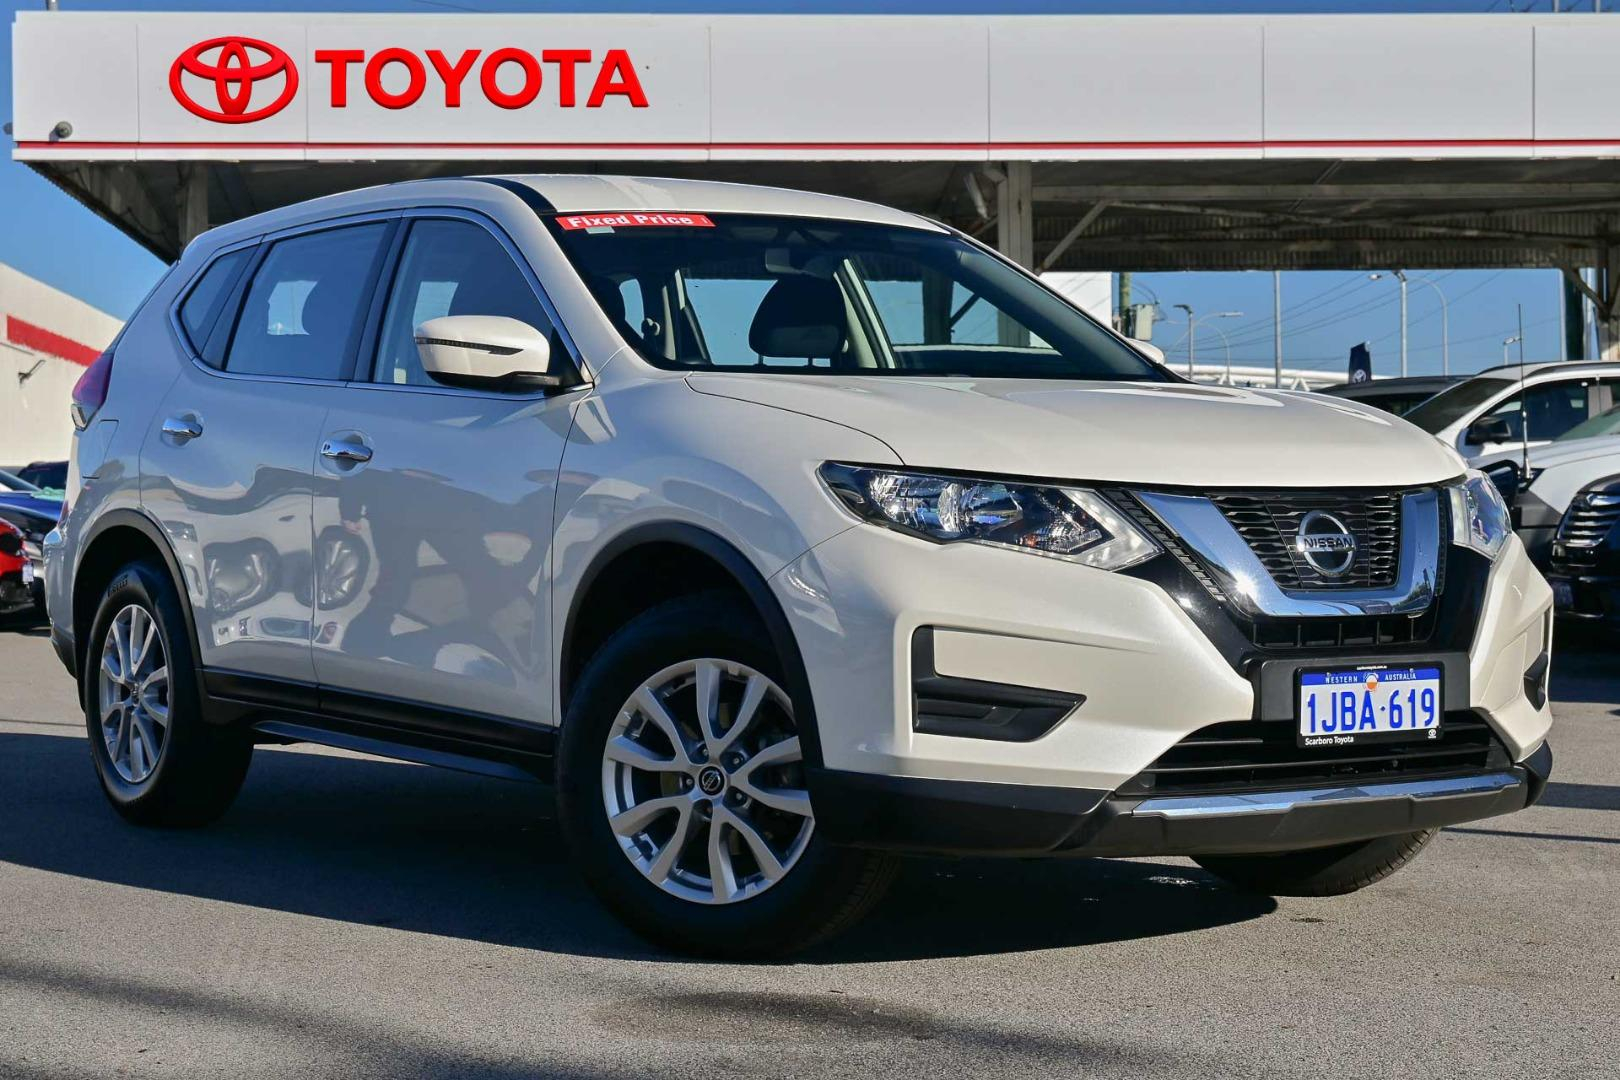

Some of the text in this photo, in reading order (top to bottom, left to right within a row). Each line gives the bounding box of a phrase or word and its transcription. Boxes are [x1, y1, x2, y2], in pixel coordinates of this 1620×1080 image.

[315, 47, 649, 109] TOYOTA
[568, 214, 693, 228] Fixed Price
[1304, 537, 1353, 548] NISSAN
[1325, 672, 1417, 684] WESTERN AUSTRALIA
[1305, 735, 1355, 746] Scarboro Toyota
